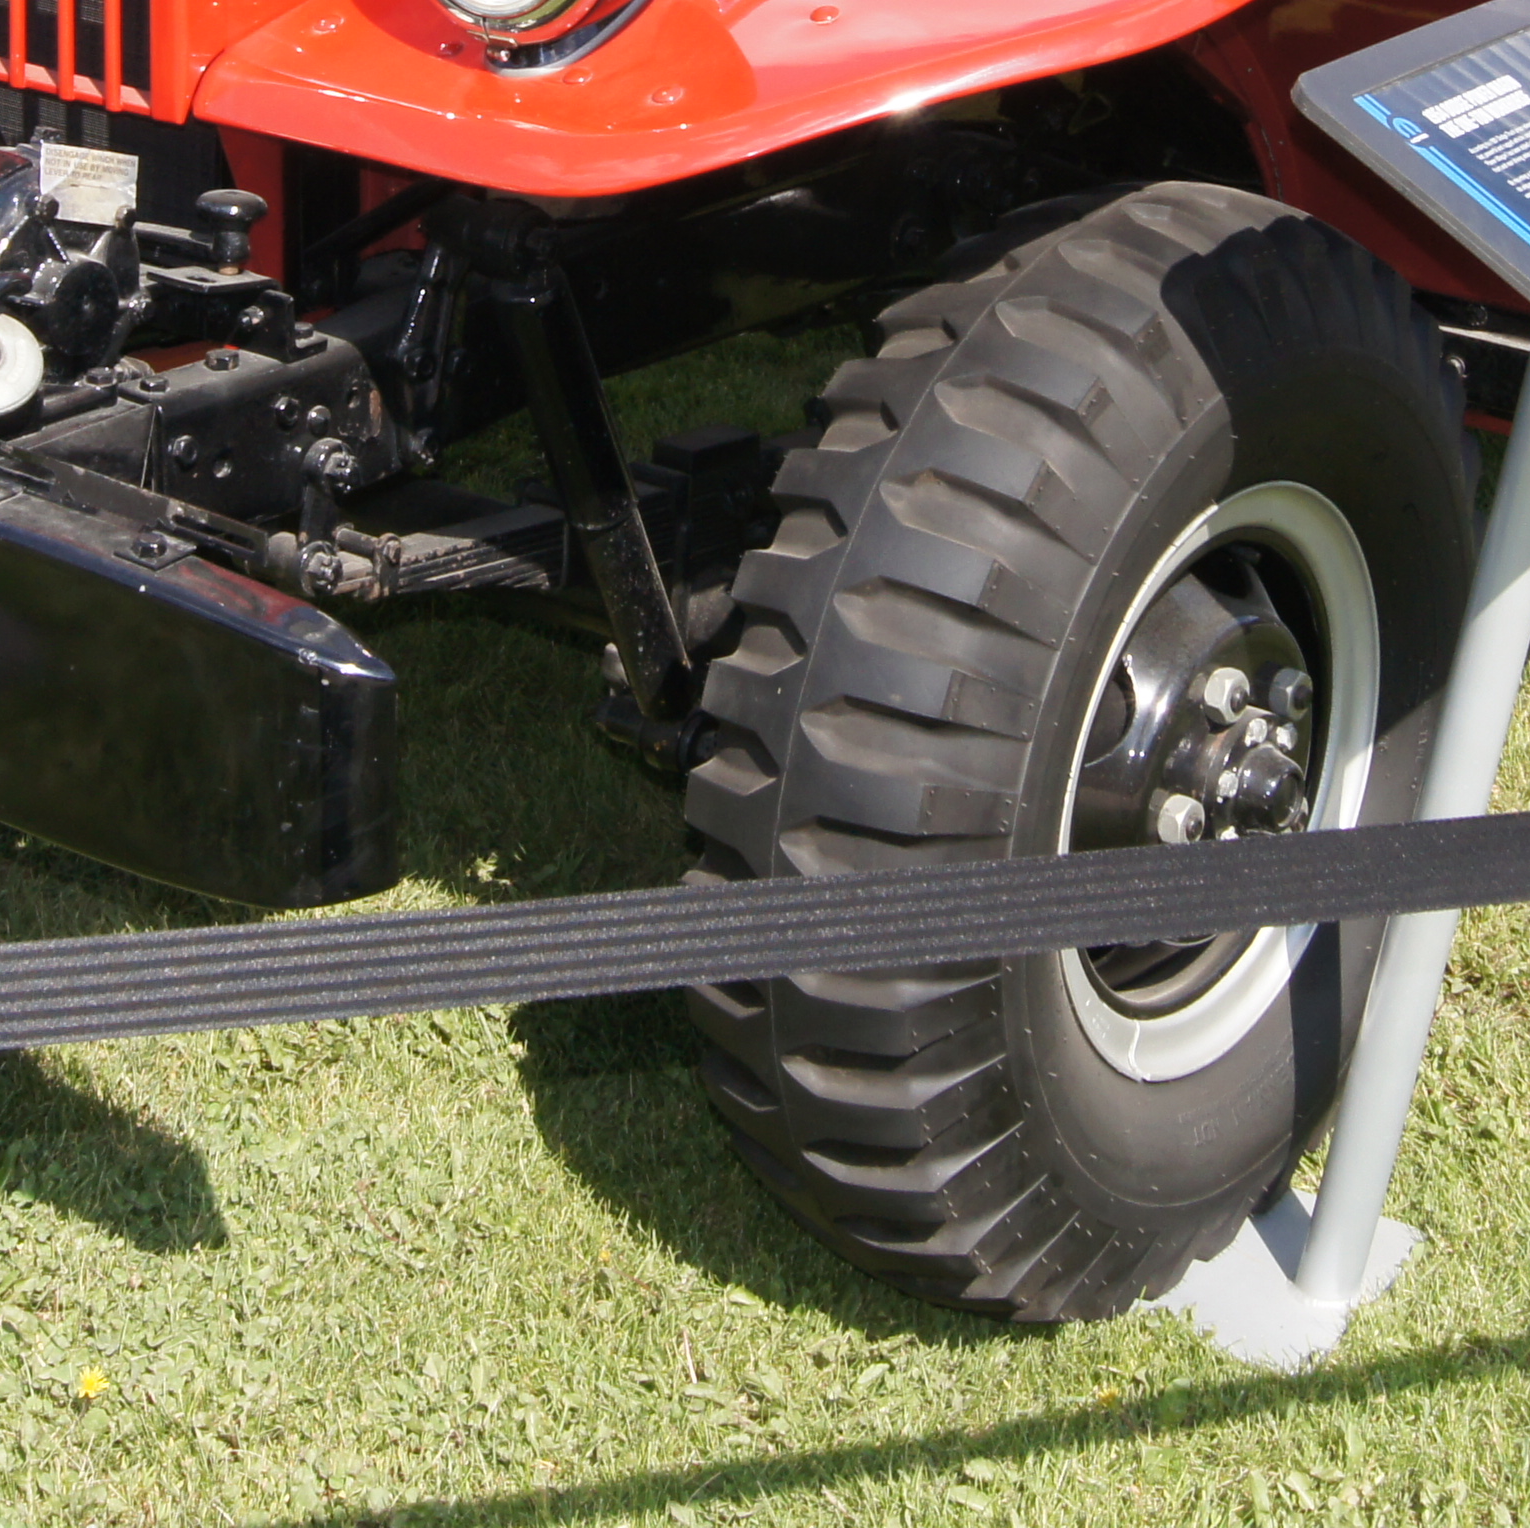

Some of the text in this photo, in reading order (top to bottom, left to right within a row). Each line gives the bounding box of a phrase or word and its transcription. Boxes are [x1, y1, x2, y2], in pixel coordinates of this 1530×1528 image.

[44, 157, 61, 166] NOT
[63, 159, 71, 167] IN
[74, 161, 88, 171] USE
[90, 163, 100, 172] BY
